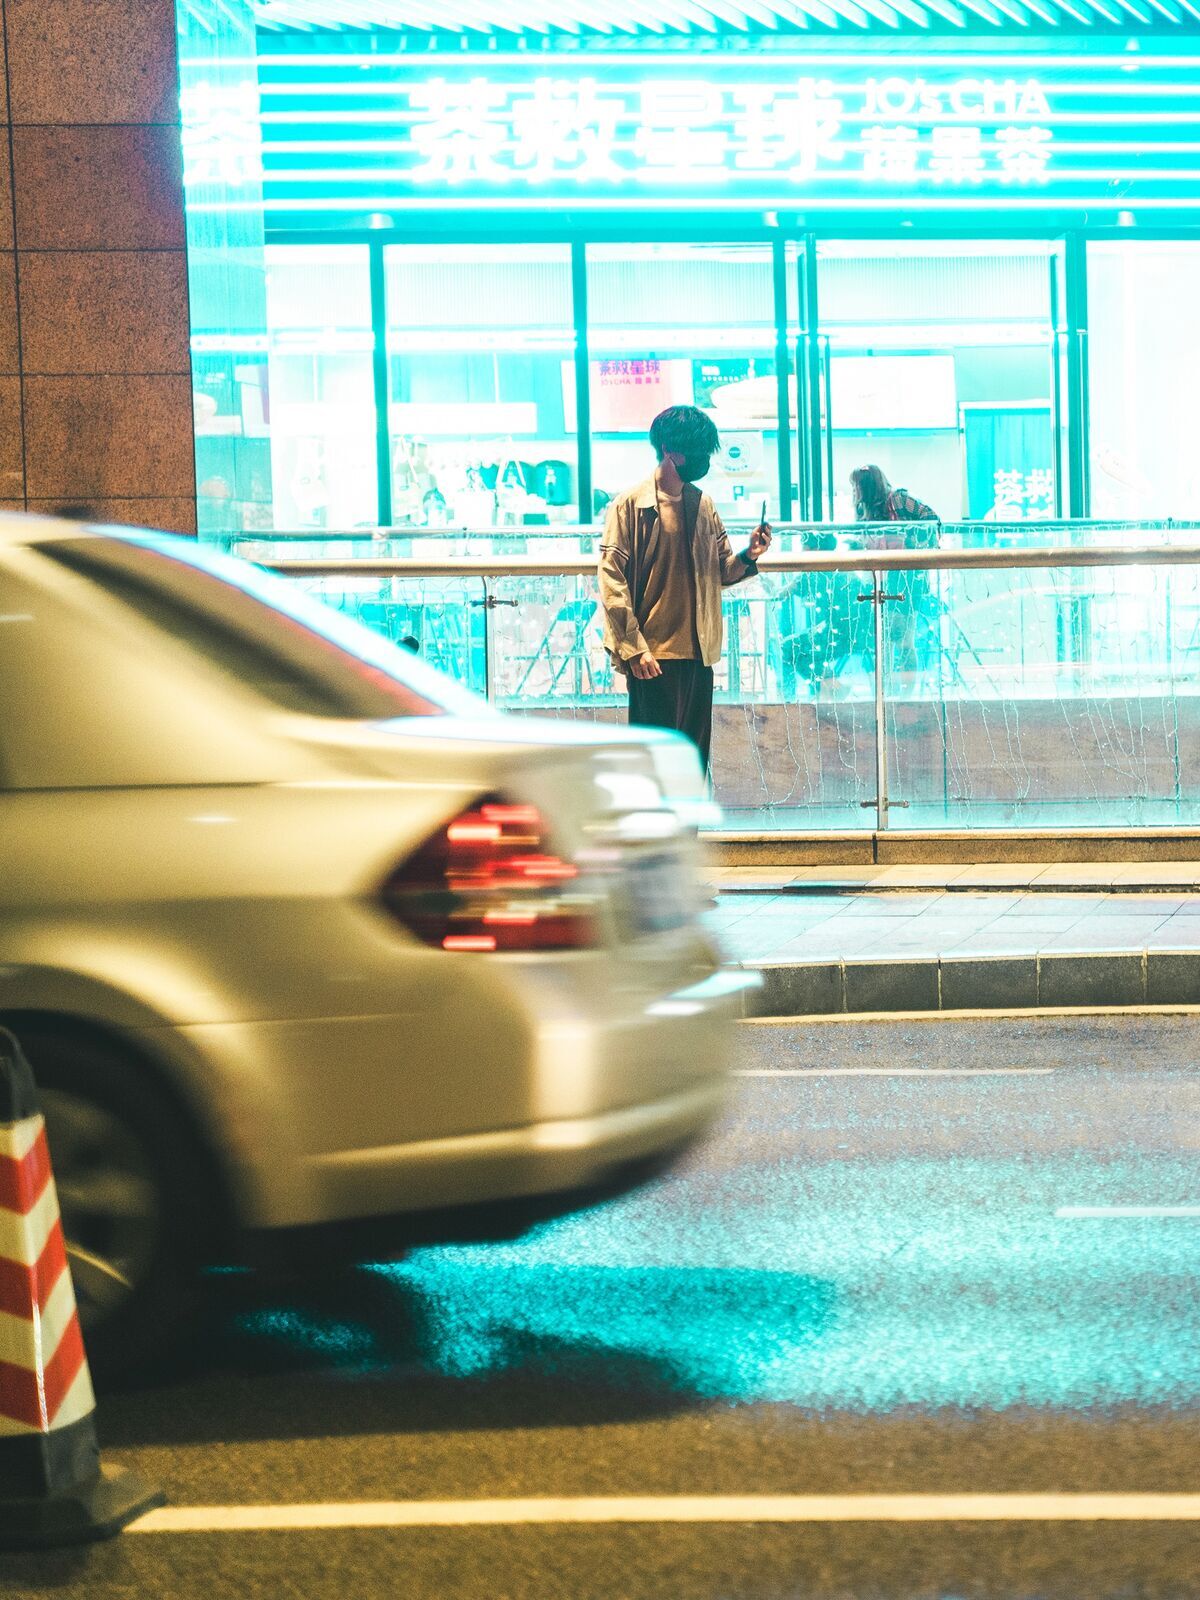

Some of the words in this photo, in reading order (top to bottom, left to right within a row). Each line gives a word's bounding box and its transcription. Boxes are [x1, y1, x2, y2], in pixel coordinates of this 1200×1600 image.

[409, 77, 844, 184] 茶救星球
[951, 79, 1050, 115] CHA
